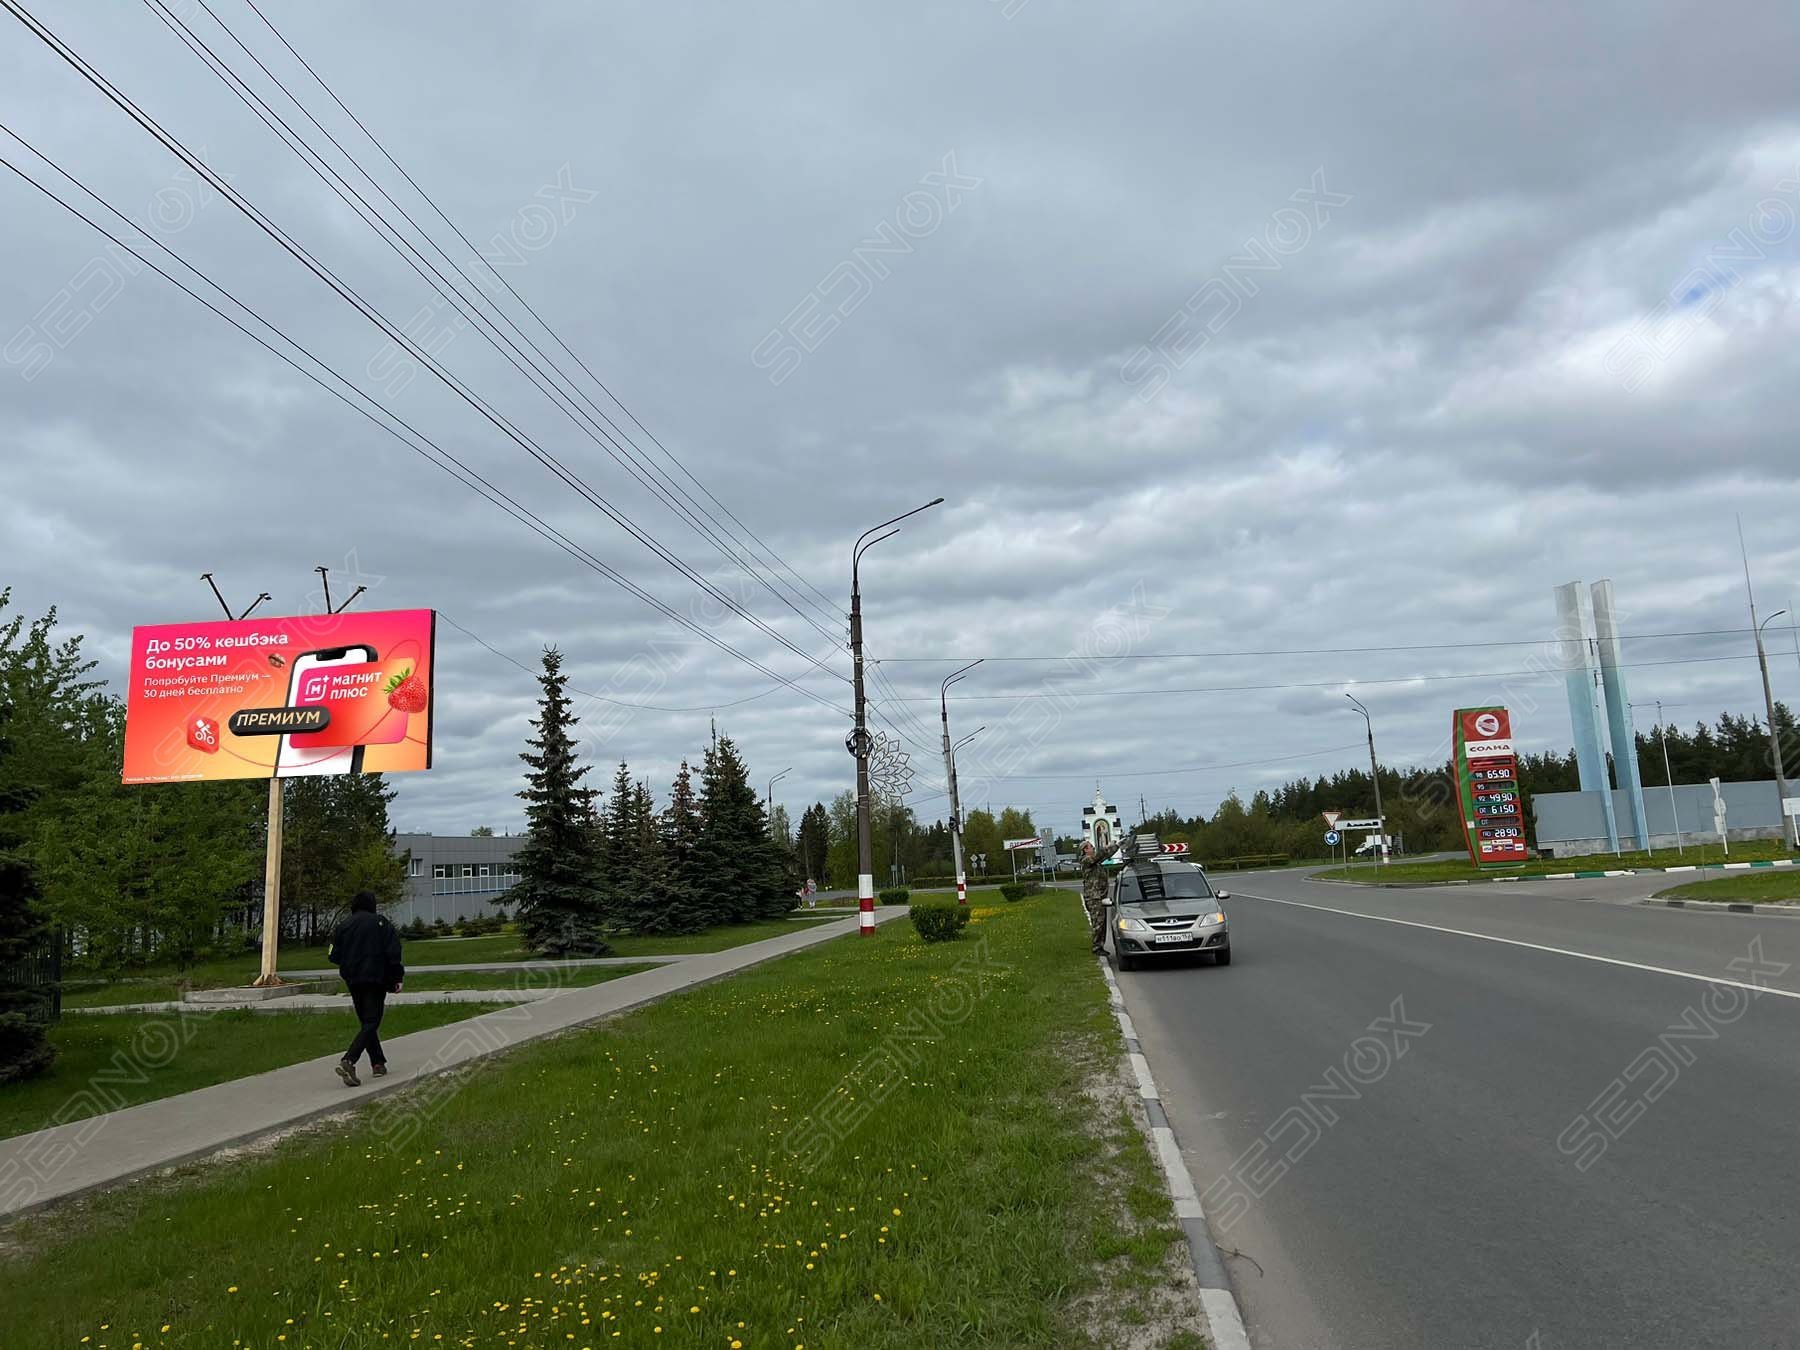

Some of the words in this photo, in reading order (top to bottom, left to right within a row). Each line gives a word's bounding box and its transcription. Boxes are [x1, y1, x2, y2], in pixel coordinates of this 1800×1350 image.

[146, 639, 171, 654] До
[174, 636, 211, 651] 50%
[215, 632, 289, 649] кешбэка
[145, 655, 227, 671] бонусами
[144, 674, 208, 688] Попробуйте
[210, 673, 259, 685] Премиум
[144, 689, 157, 698] 30
[159, 685, 185, 698] дней
[187, 685, 244, 697] бесплатно
[236, 710, 321, 727] ПРЕМИУМ
[1470, 744, 1511, 752] СОЛИД
